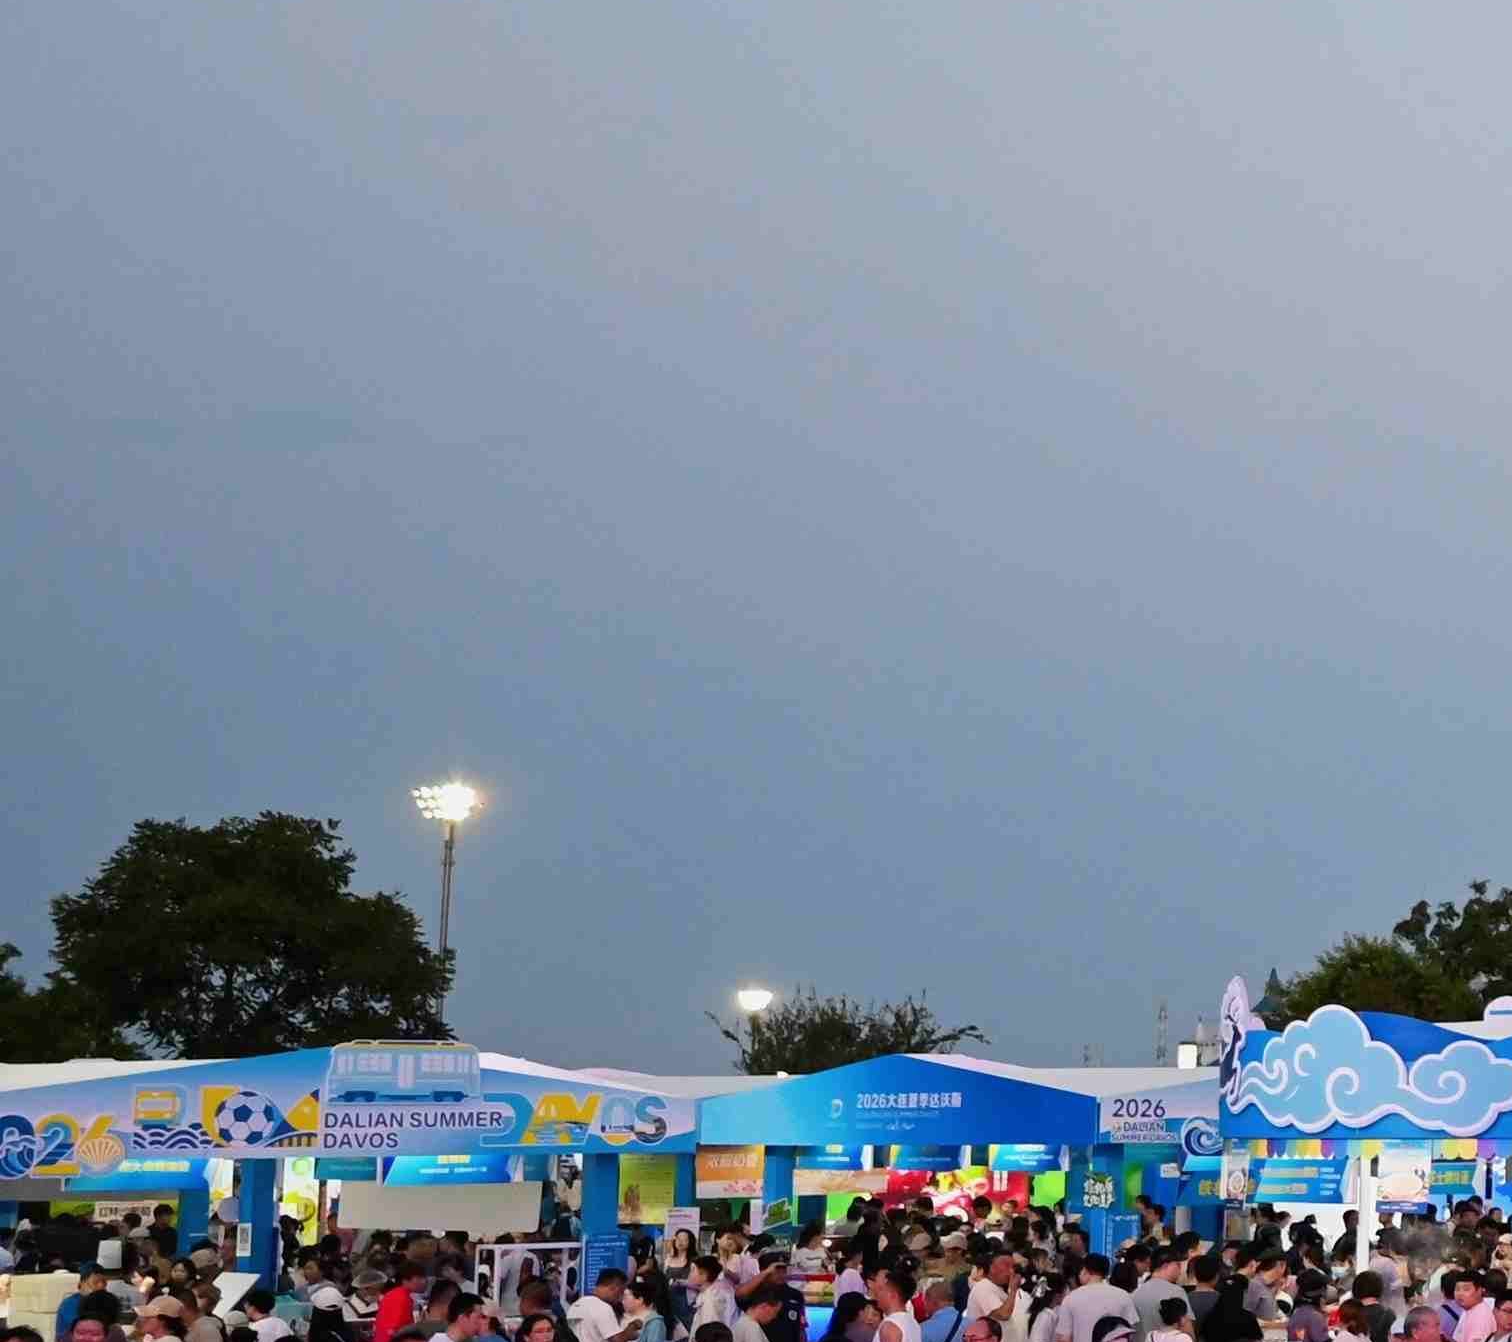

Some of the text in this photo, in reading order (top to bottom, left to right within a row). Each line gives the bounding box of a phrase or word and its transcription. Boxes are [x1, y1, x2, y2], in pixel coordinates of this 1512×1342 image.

[1112, 1098, 1166, 1118] 2026
[324, 1110, 503, 1129] DALIAN SUMMER
[323, 1132, 399, 1149] DAVOS
